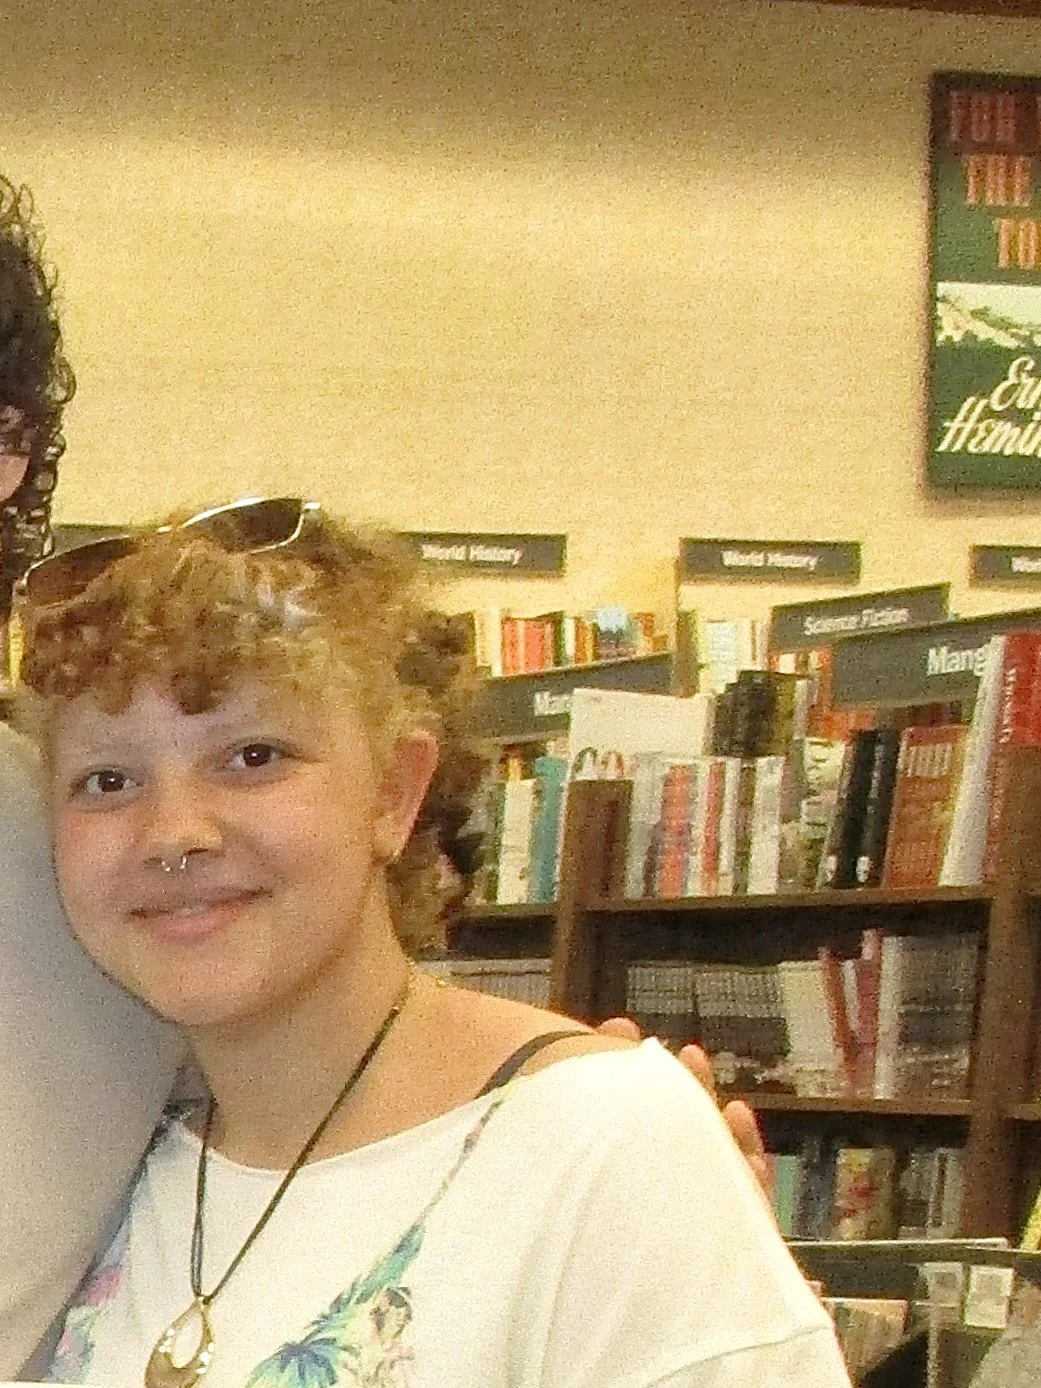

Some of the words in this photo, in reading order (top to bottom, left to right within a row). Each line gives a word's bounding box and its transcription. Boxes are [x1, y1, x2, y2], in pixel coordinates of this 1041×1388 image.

[470, 544, 524, 565] History
[768, 552, 820, 572] History
[860, 607, 910, 629] Fiction
